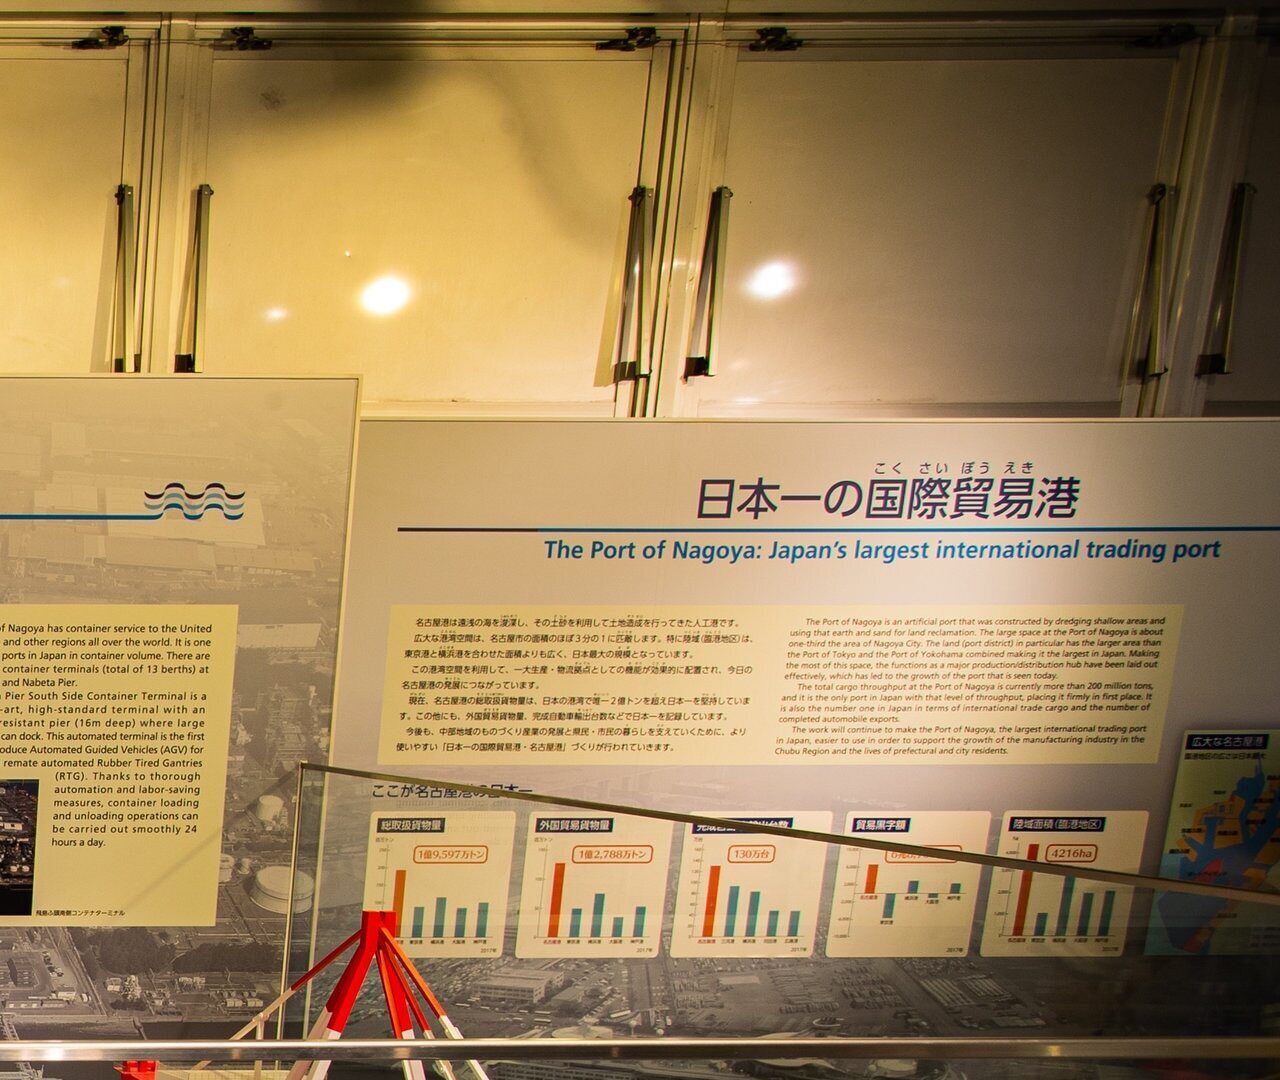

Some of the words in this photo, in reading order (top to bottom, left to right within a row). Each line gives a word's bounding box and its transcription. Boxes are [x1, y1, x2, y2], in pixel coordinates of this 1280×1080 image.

[697, 477, 1080, 519] 日本一の国際貿易港
[544, 539, 583, 559] The
[590, 540, 636, 559] Port
[642, 539, 666, 559] of
[672, 541, 761, 564] Nagoya:
[768, 541, 847, 563] Japan's
[854, 540, 929, 563] largest
[936, 539, 1079, 558] international
[1085, 538, 1166, 563] trading
[1171, 541, 1222, 562] port
[7, 623, 44, 635] Nagoya
[47, 623, 63, 633] has
[65, 623, 111, 633] container
[113, 623, 145, 633] service
[148, 624, 158, 633] to
[160, 623, 177, 633] the
[179, 624, 212, 633] United
[1051, 848, 1092, 858] 4216ha
